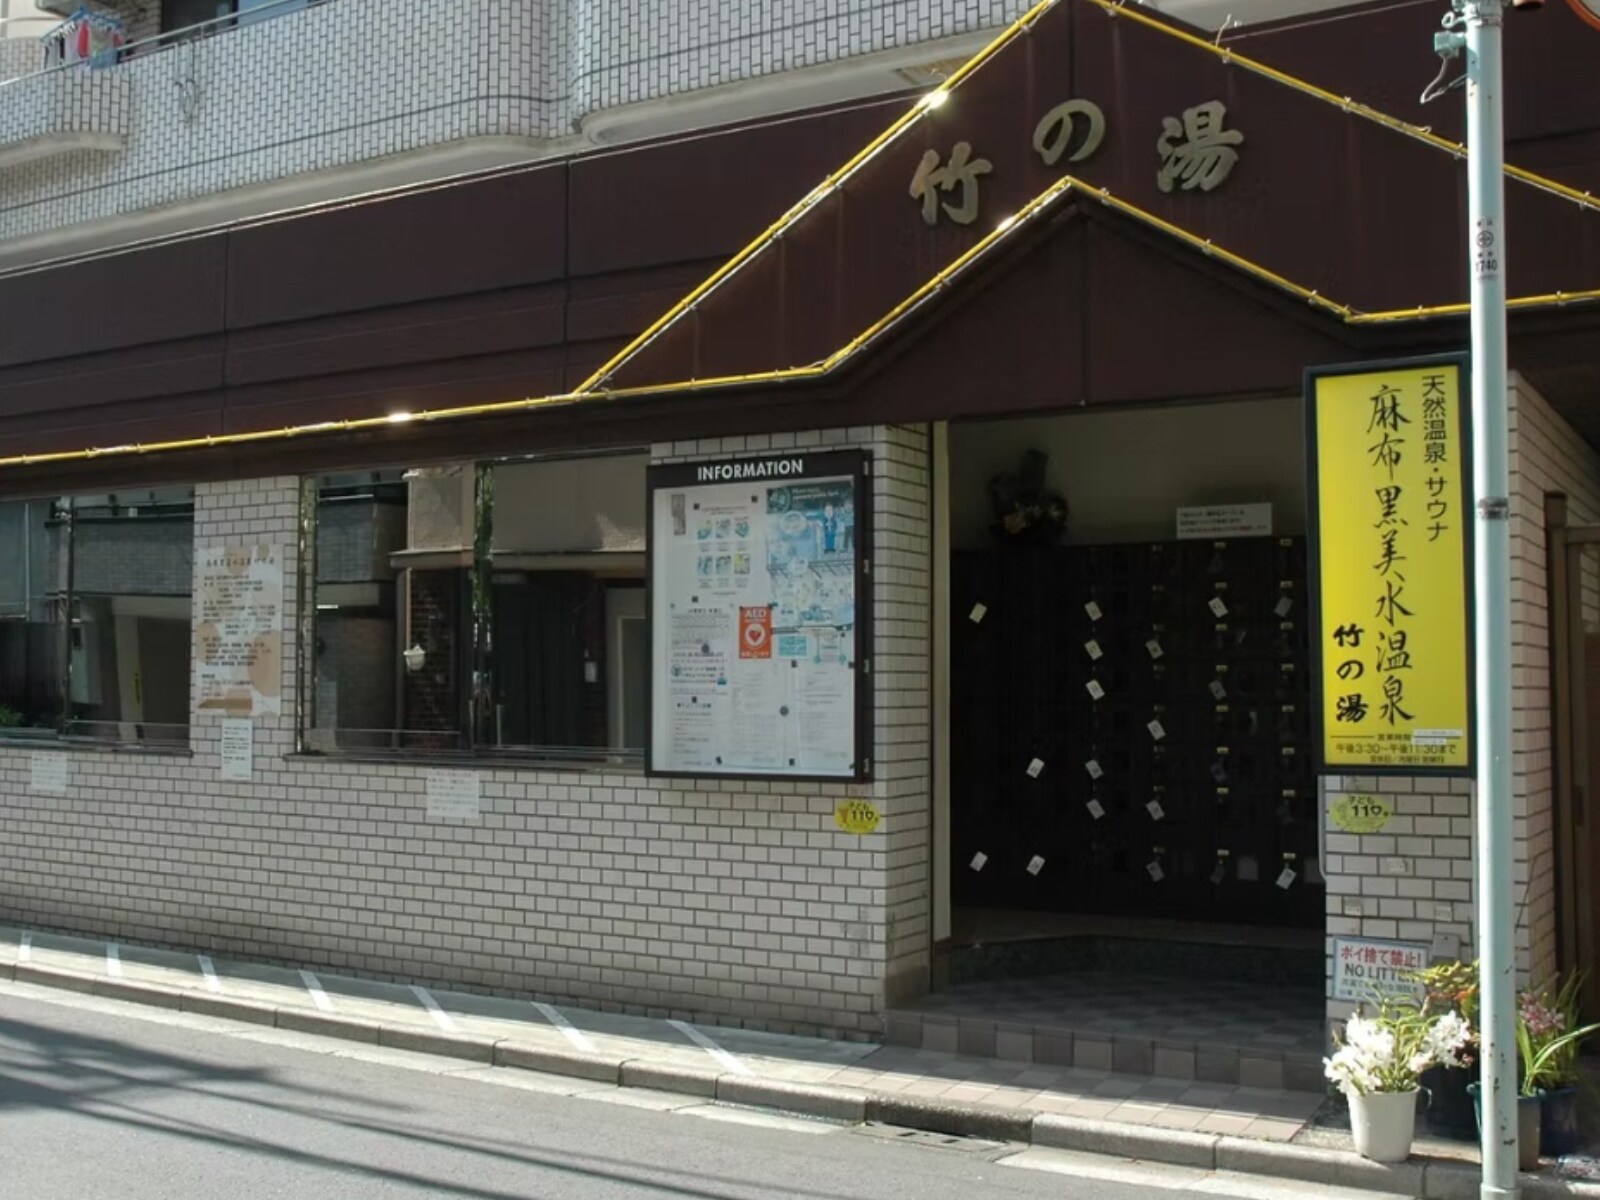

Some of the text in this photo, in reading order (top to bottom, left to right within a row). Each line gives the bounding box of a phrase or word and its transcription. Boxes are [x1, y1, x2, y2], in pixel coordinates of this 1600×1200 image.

[909, 99, 1244, 225] 竹の湯
[697, 459, 804, 481] INFORMATION
[1366, 383, 1416, 727] 麻布黒美水温泉
[1332, 622, 1370, 723] 竹の湯
[1344, 963, 1365, 977] NO
